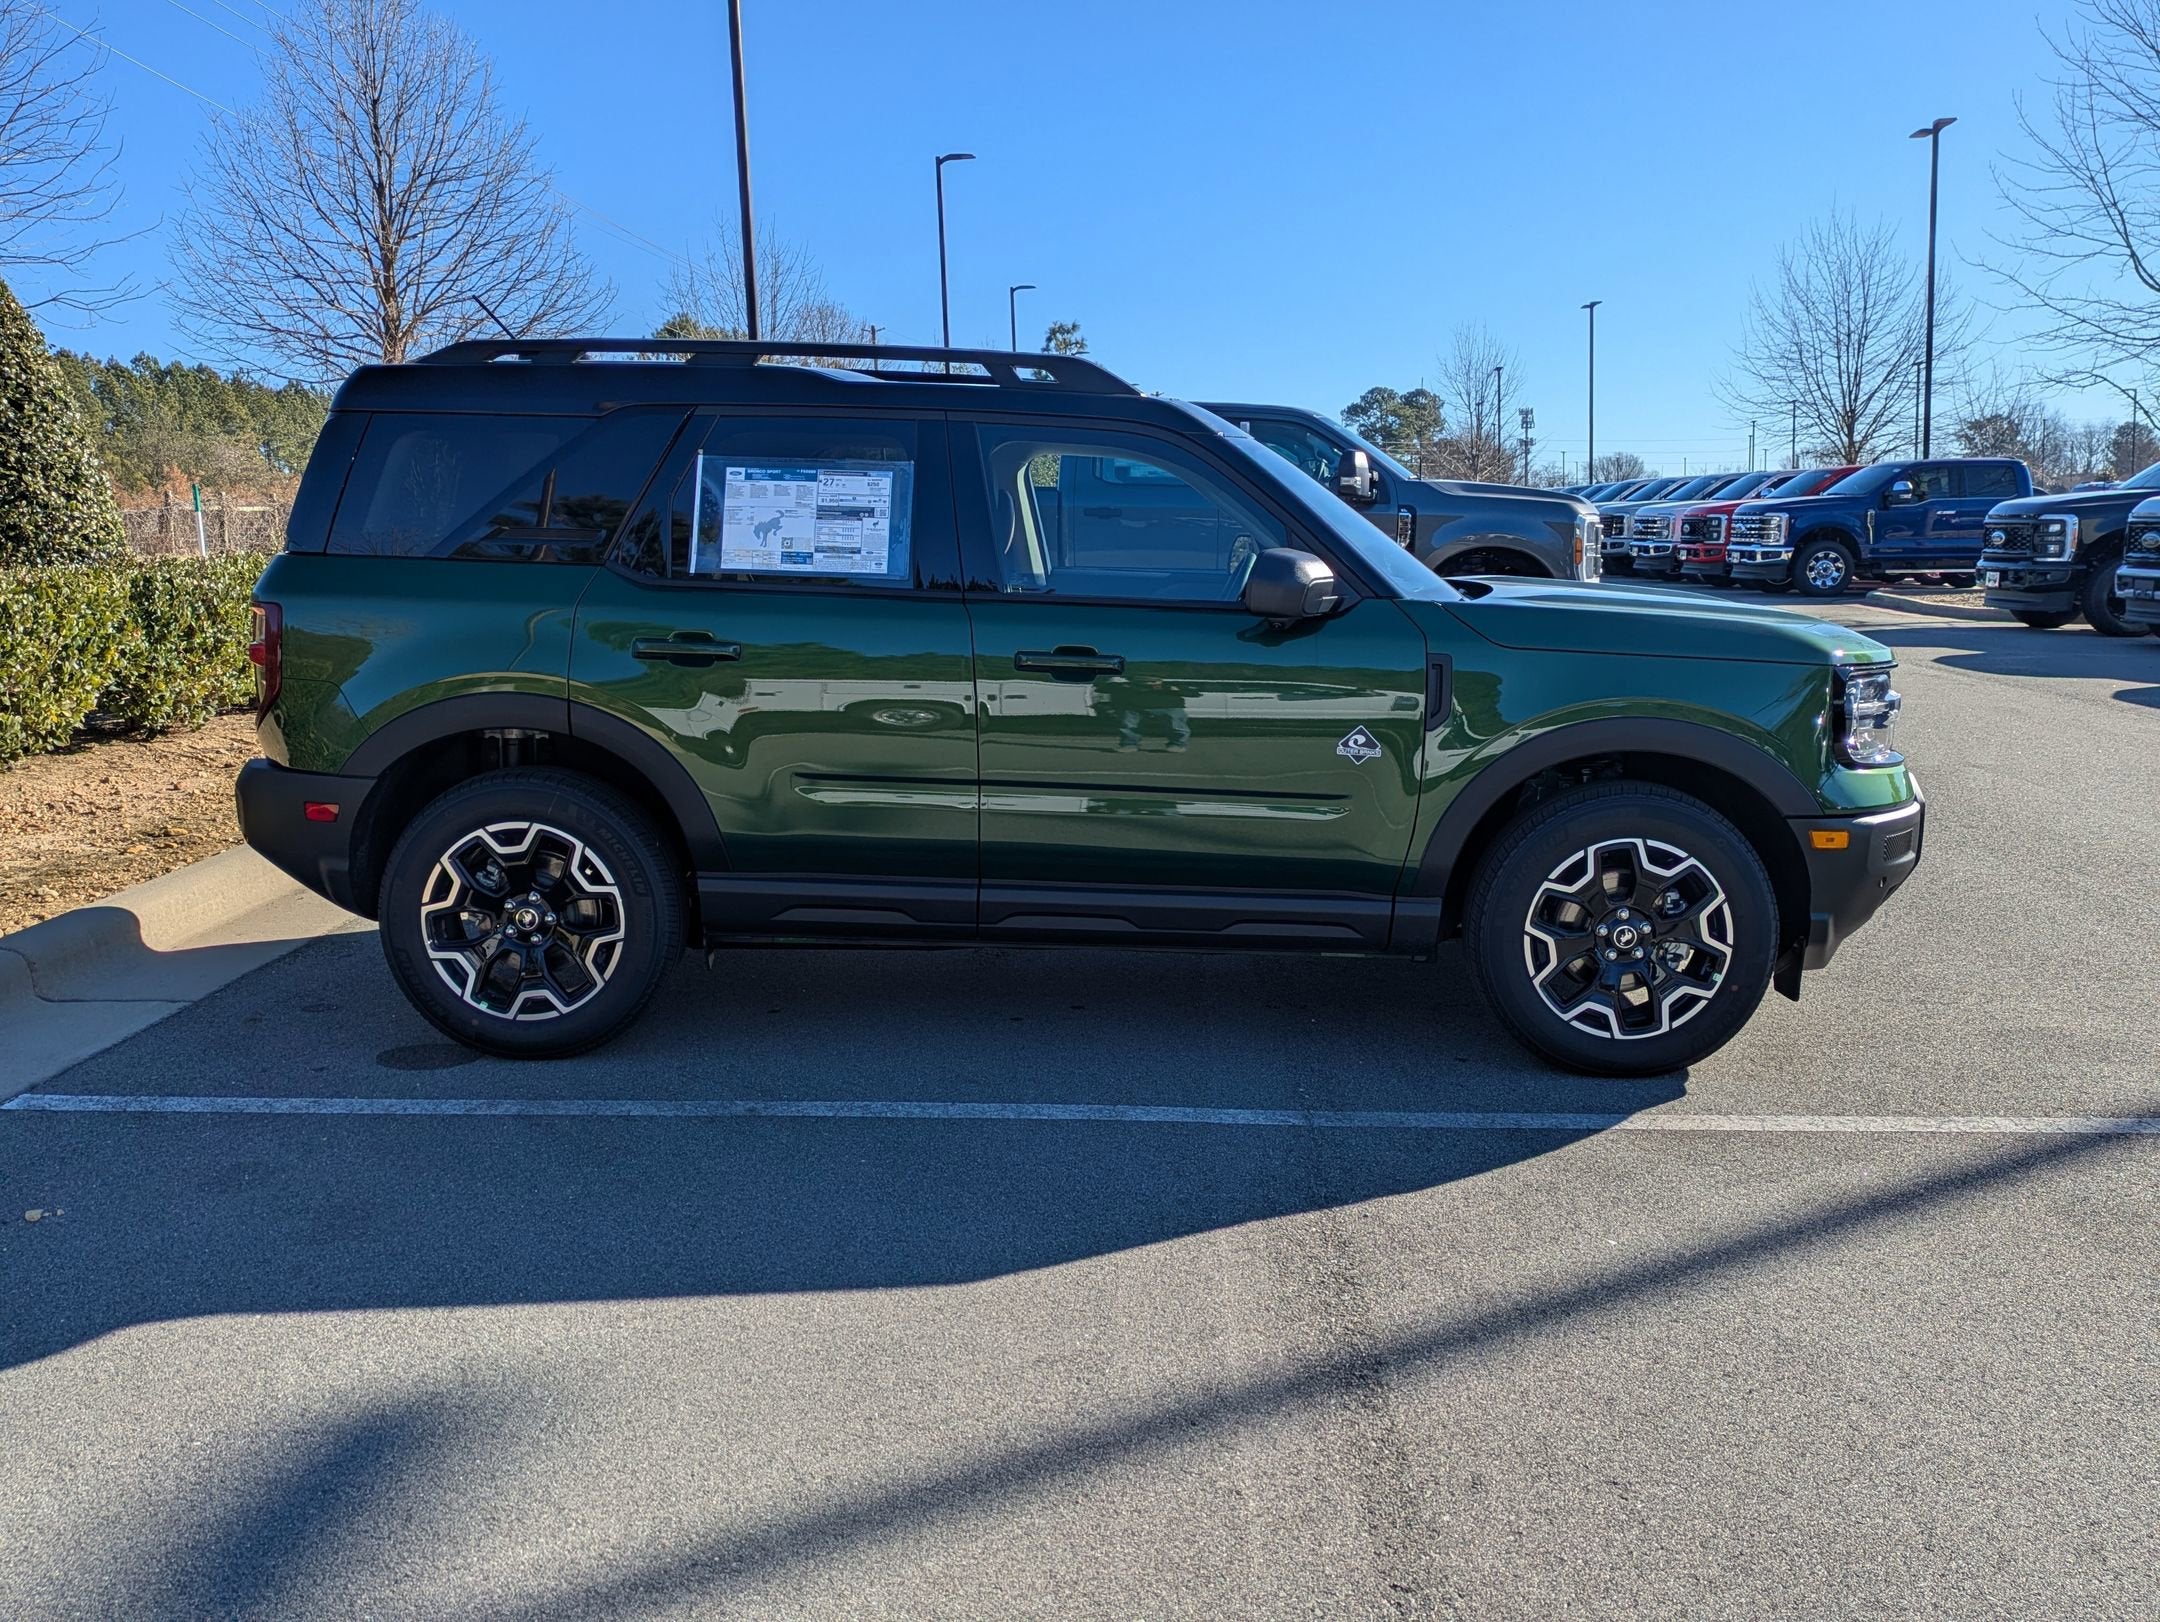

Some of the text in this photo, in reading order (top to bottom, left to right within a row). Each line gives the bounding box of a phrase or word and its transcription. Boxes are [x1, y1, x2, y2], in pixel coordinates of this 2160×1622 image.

[823, 478, 835, 487] 27
[1338, 747, 1380, 756] OUTER BANKS
[598, 828, 648, 896] MICHELIN
